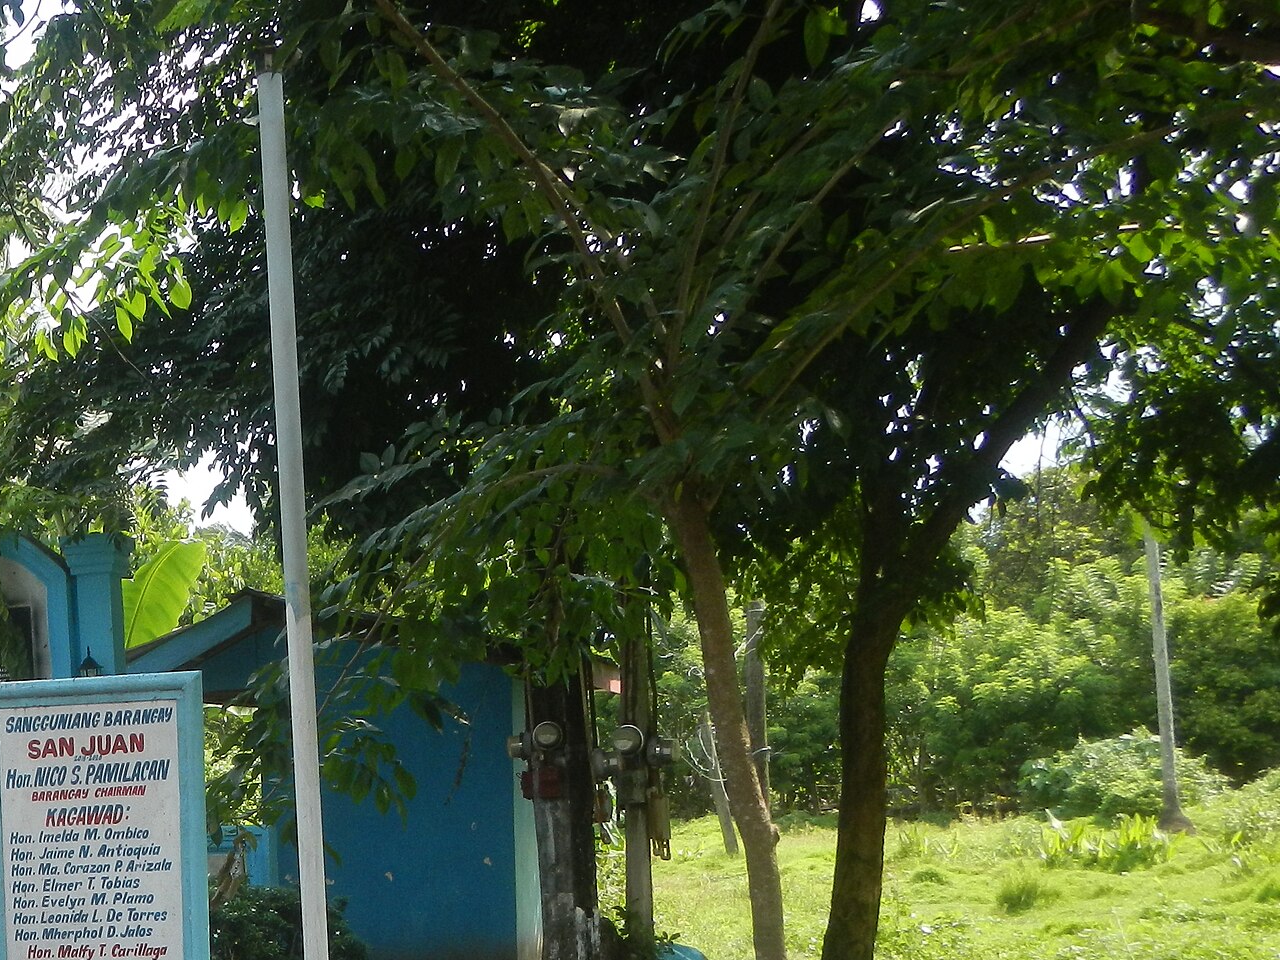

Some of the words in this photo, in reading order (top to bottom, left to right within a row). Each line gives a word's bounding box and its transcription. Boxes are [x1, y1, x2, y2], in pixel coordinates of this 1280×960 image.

[5, 712, 101, 734] SANGGUNIANG
[103, 707, 172, 727] BARANGAY
[27, 737, 74, 759] SAN
[81, 733, 144, 757] JUAN
[6, 769, 32, 790] Hon.
[34, 766, 67, 787] NICO
[71, 766, 82, 785] S.
[85, 759, 170, 785] PAMILACAN
[32, 788, 89, 802] BARANGAY
[95, 785, 146, 797] CHAIRMAN
[45, 804, 130, 827] KAGAWAD:
[10, 833, 34, 844] Hon.
[39, 830, 79, 843] Imelda
[84, 829, 100, 841] M.
[11, 848, 35, 861] Hon.
[39, 847, 74, 859] Jaime
[79, 846, 92, 858] N.
[98, 843, 161, 860] Antioquia
[11, 864, 35, 876] Hon.
[39, 864, 60, 875] Ma.
[64, 861, 110, 874] Corazon
[115, 861, 122, 872] P.
[126, 859, 172, 872] Arizala
[12, 881, 38, 893] Hon.
[43, 879, 82, 892] Elmer
[87, 878, 95, 890] T.
[100, 876, 140, 889] Tobias
[13, 896, 38, 909] Hon.
[42, 895, 85, 909] Evelyn
[90, 894, 108, 905] M.
[113, 892, 154, 904] Plamo
[14, 913, 38, 925] Hon.
[41, 910, 88, 924] Leonida
[92, 910, 102, 922] L.
[107, 909, 124, 922] De
[127, 908, 167, 922] Torres
[15, 929, 39, 941] Hon.
[107, 926, 118, 938] D.
[119, 926, 153, 938] Jalos
[27, 945, 55, 959] Hon.
[99, 945, 107, 956] T.
[112, 943, 167, 960] Carillaga
